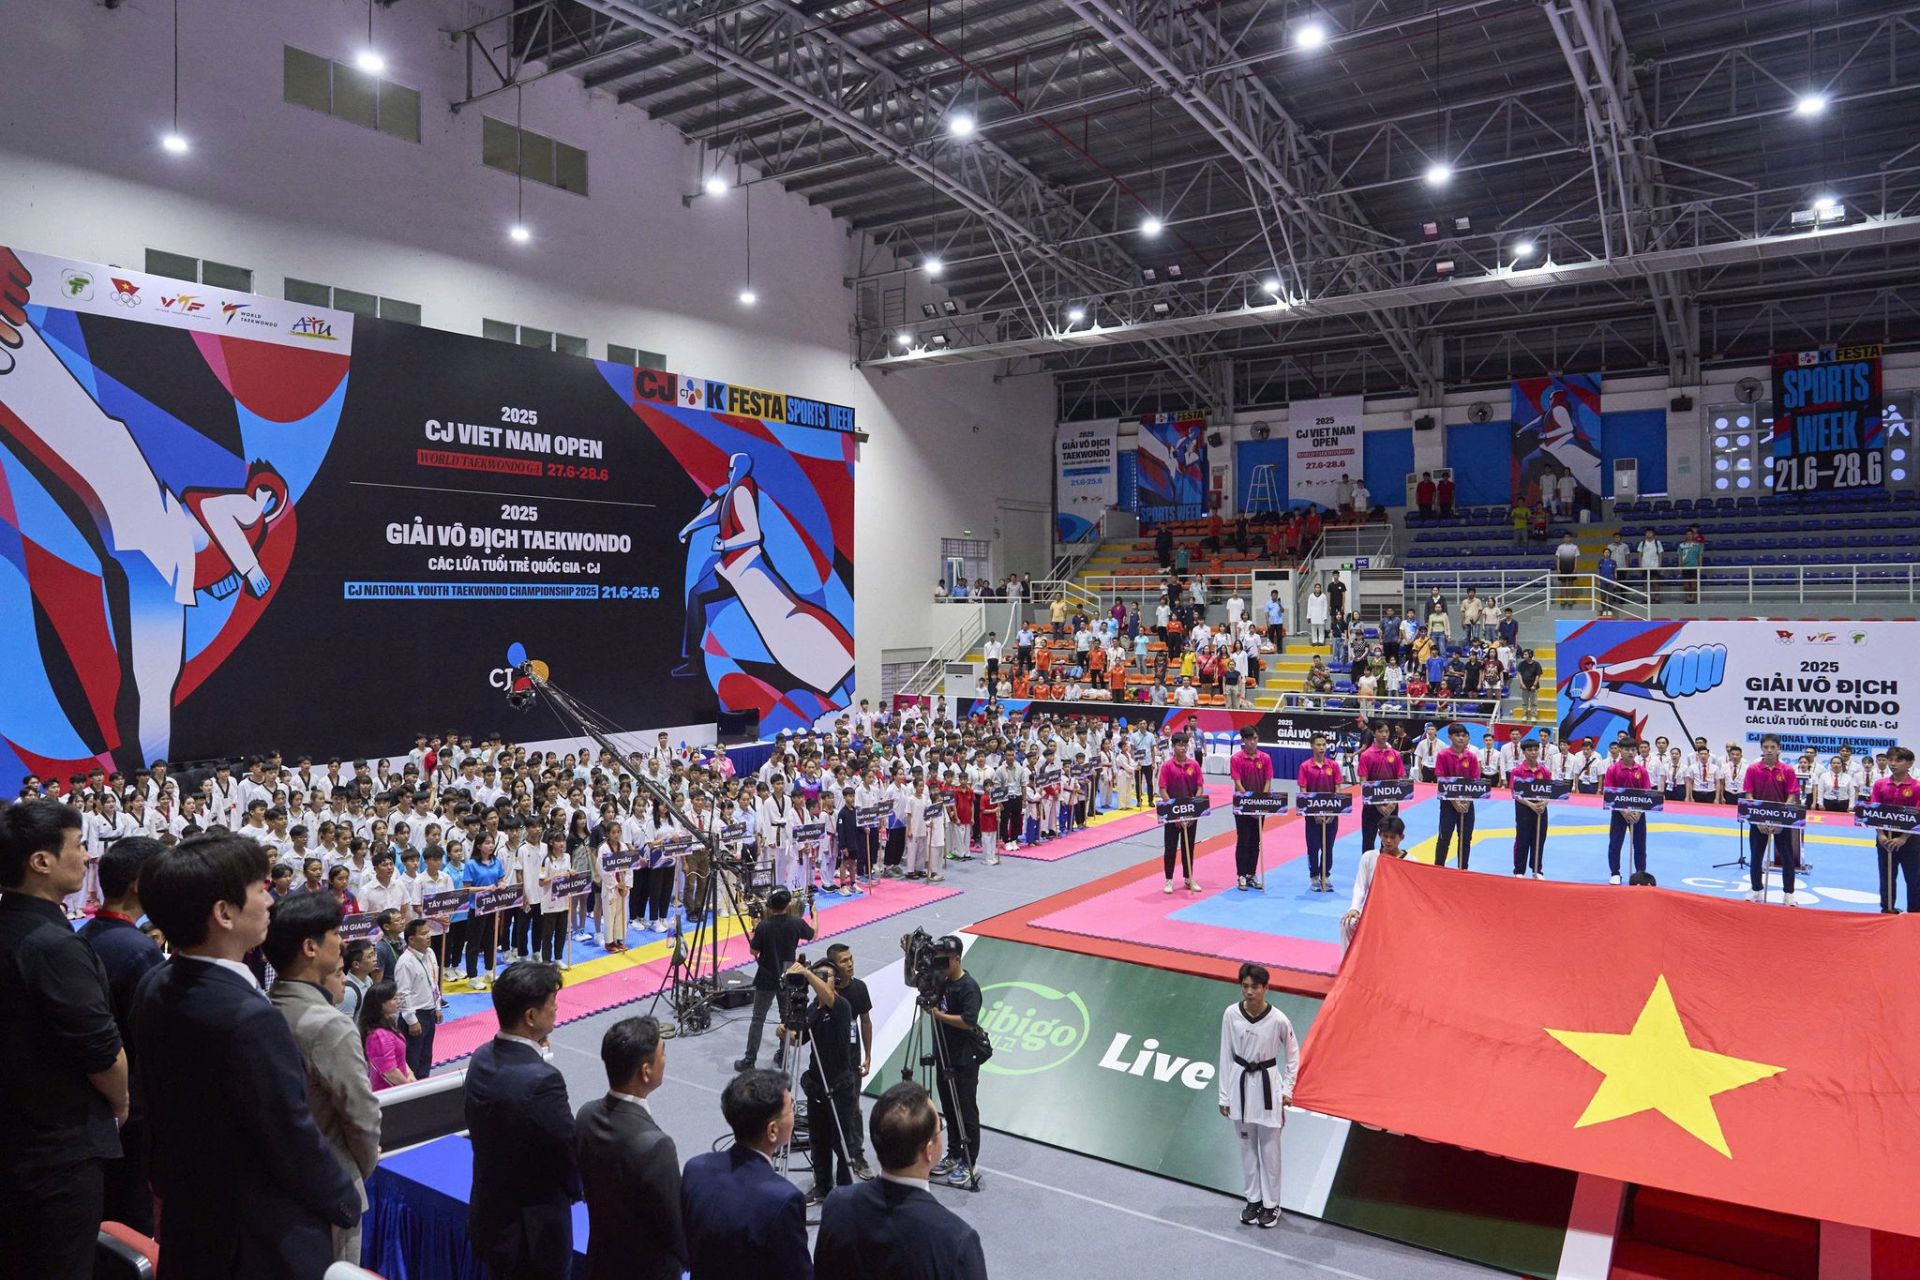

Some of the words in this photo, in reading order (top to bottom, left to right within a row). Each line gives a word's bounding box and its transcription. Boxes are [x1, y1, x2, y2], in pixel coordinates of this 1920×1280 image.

[240, 311, 262, 319] WORLD
[240, 317, 278, 328] TAEKWONDO
[1835, 345, 1882, 361] FESTA
[1783, 362, 1870, 409] SPORTS
[636, 370, 676, 399] CJ
[707, 383, 725, 410] K
[728, 387, 784, 420] FESTA
[787, 399, 826, 427] SPORTS
[828, 404, 854, 431] WEEK
[501, 406, 538, 426] 2025
[1315, 416, 1335, 425] 2025
[1296, 429, 1309, 439] CJ
[1309, 427, 1331, 438] VIET
[1332, 425, 1356, 436] NAM
[1796, 411, 1858, 453] WEEK
[425, 419, 455, 443] CJ
[457, 423, 503, 448] VIET
[505, 429, 551, 454] NAM
[554, 435, 603, 459] OPEN
[1062, 438, 1079, 450] GIẢI
[1312, 437, 1339, 447] OPEN
[1062, 448, 1110, 460] TAEKWONDO
[420, 451, 460, 466] WORLD
[461, 454, 526, 474] TAEKWONDO
[547, 463, 609, 481] 27.6-28.6
[501, 504, 538, 522] 2025
[1140, 506, 1176, 523] SPORTS
[386, 515, 434, 546] GIẢI
[436, 522, 466, 547] VÔ
[469, 527, 519, 554] ĐỊCH
[521, 529, 632, 553] TAEKWONDO
[428, 555, 455, 571] CÁC
[456, 555, 480, 572] LỨA
[481, 554, 508, 572] TUỔI
[509, 556, 530, 573] TRẺ
[531, 556, 561, 574] QUỐC
[562, 561, 580, 574] GIA
[586, 562, 601, 574] CJ
[348, 584, 362, 596] CJ
[364, 584, 416, 596] NATIONAL
[417, 585, 449, 596] YOUTH
[451, 585, 508, 597] TAEKWONDO
[509, 586, 575, 597] CHAMPIONSHIP
[575, 586, 597, 597] 2025
[601, 585, 660, 599] 21.6-25.6
[1799, 661, 1840, 673] 2025
[489, 667, 514, 691] CJ
[1745, 672, 1793, 692] GIẢI
[1797, 676, 1831, 693] VÔ
[1835, 679, 1898, 699] ĐỊCH
[1744, 697, 1900, 716] TAEKWONDO
[1745, 714, 1765, 724] CÁC
[1766, 714, 1786, 725] LỨA
[1788, 715, 1809, 727] TUỔI
[1810, 716, 1829, 728] TRẺ
[1830, 716, 1858, 728] QUỐC
[1859, 720, 1878, 729] GIA
[1885, 720, 1899, 730] CJ
[1277, 726, 1297, 738] GIẢI
[1298, 728, 1312, 739] VÔ
[1748, 734, 1760, 742] CJ
[1806, 736, 1836, 745] YOUTH
[1838, 738, 1896, 747] TAEKWONDO
[1373, 787, 1402, 796] INDIA
[1442, 784, 1463, 792] VIET
[1464, 785, 1487, 793] NAM
[1530, 784, 1552, 793] UAE
[1239, 798, 1282, 806] AFGHANISTAN
[1307, 799, 1342, 808] JAPAN
[1614, 795, 1653, 804] ARMENIA
[1172, 804, 1196, 814] GBR
[1782, 811, 1797, 819] TÀI
[1863, 809, 1917, 823] MALAYSIA
[571, 879, 587, 888] LONG
[442, 897, 460, 906] NINH
[498, 892, 518, 901] VINH
[350, 922, 372, 931] GIANG
[977, 1000, 1077, 1051] ibigo
[1098, 1032, 1216, 1090] Live
